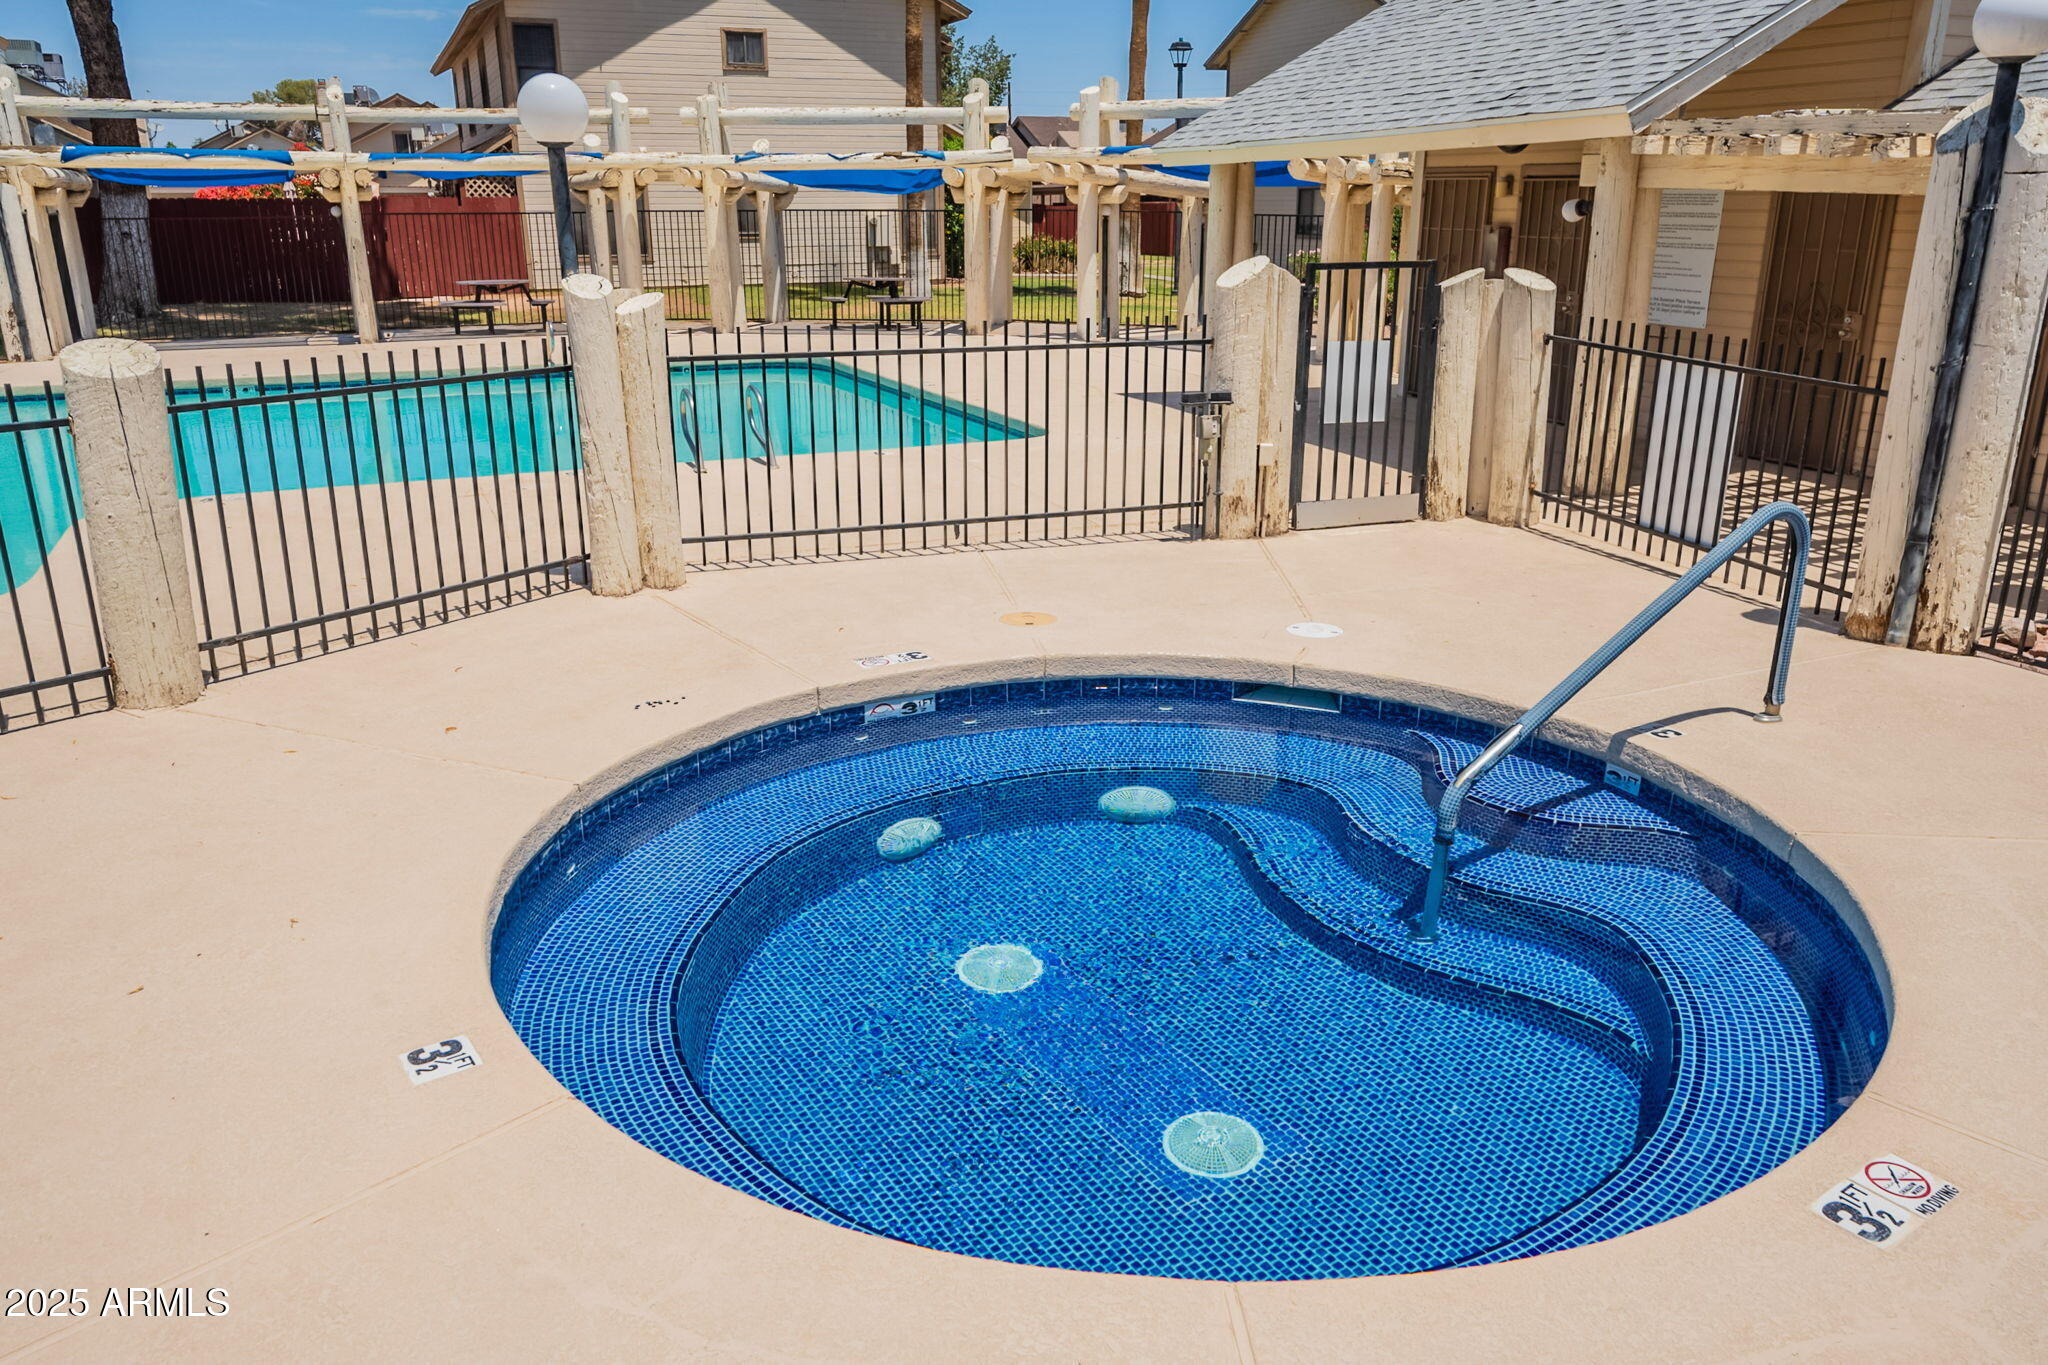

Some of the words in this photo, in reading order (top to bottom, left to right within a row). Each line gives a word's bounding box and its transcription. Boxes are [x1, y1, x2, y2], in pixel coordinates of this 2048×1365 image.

[901, 702, 918, 714] 3
[406, 1039, 463, 1066] 3
[453, 1055, 476, 1069] FT
[1839, 1183, 1868, 1202] FT
[1915, 1203, 1937, 1216] NO
[1926, 1184, 1960, 1209] DIVING
[1821, 1200, 1892, 1242] 3
